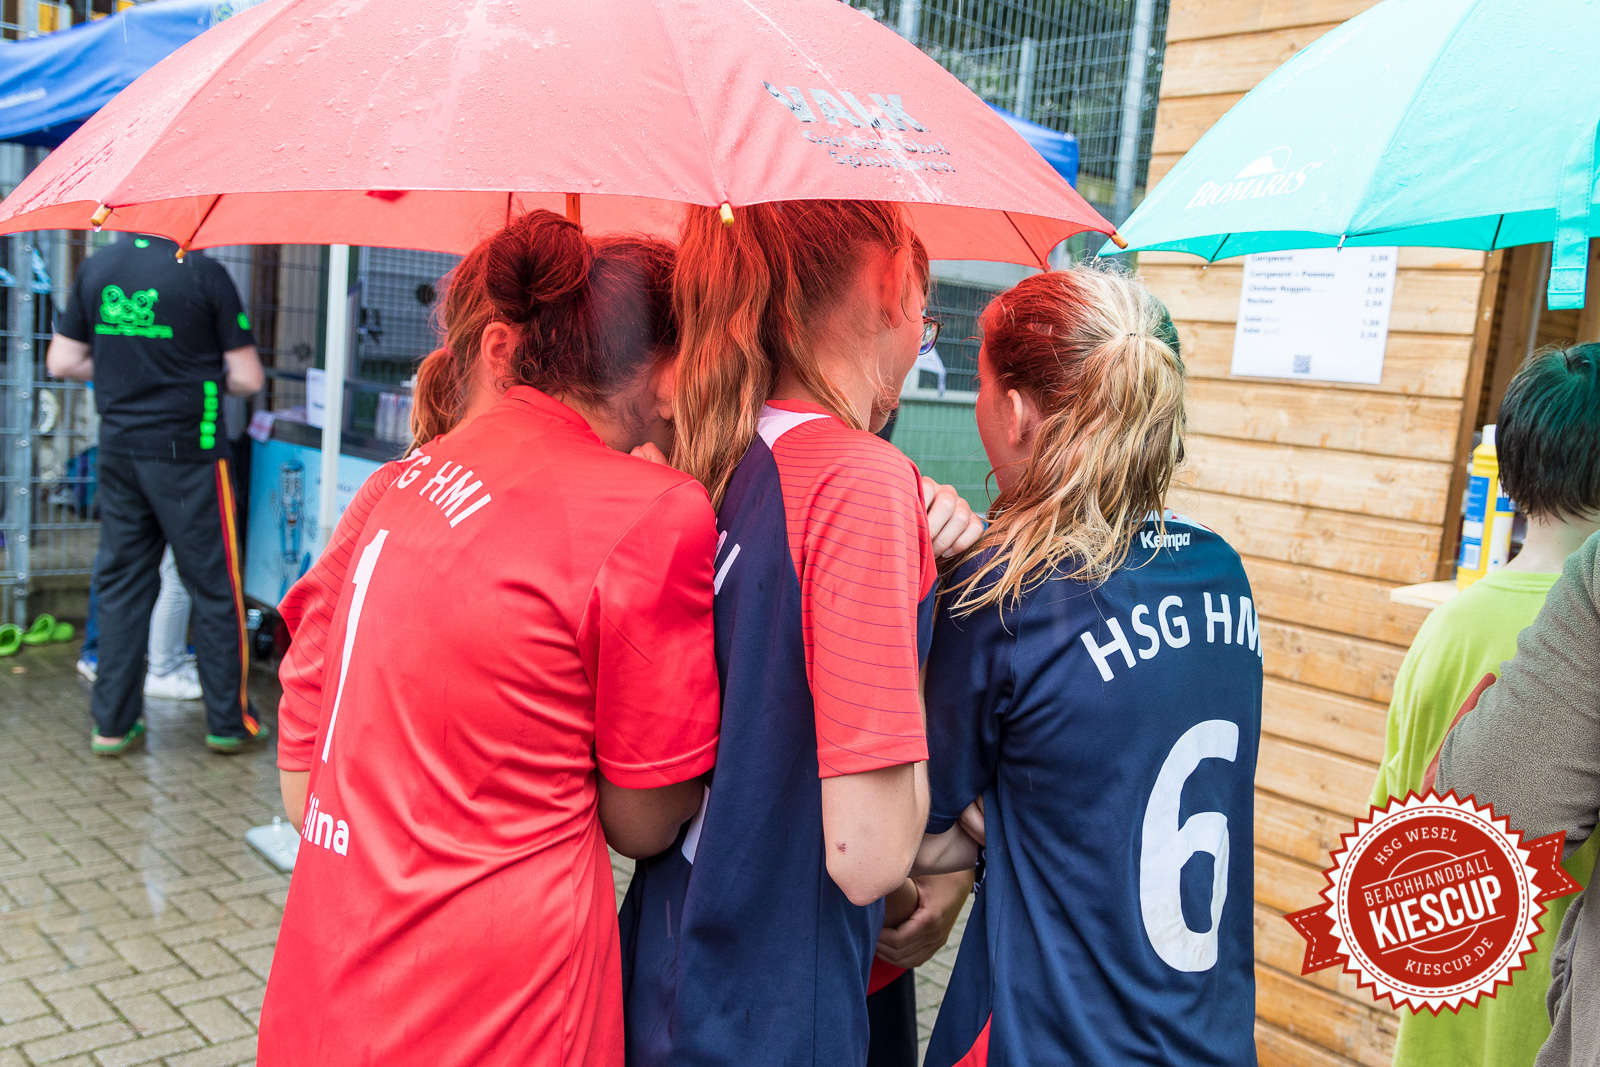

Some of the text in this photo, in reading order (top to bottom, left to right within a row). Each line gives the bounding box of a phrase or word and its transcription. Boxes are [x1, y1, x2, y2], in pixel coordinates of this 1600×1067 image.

[760, 80, 931, 133] VALK
[828, 150, 957, 173] Spielwaren
[1184, 161, 1324, 210] BIOMARIS
[418, 460, 492, 529] HMI
[1139, 530, 1191, 552] Kempa
[321, 527, 390, 765] 1
[1079, 591, 1264, 683] HSG HM
[302, 792, 350, 857] lina
[1139, 718, 1240, 973] 6
